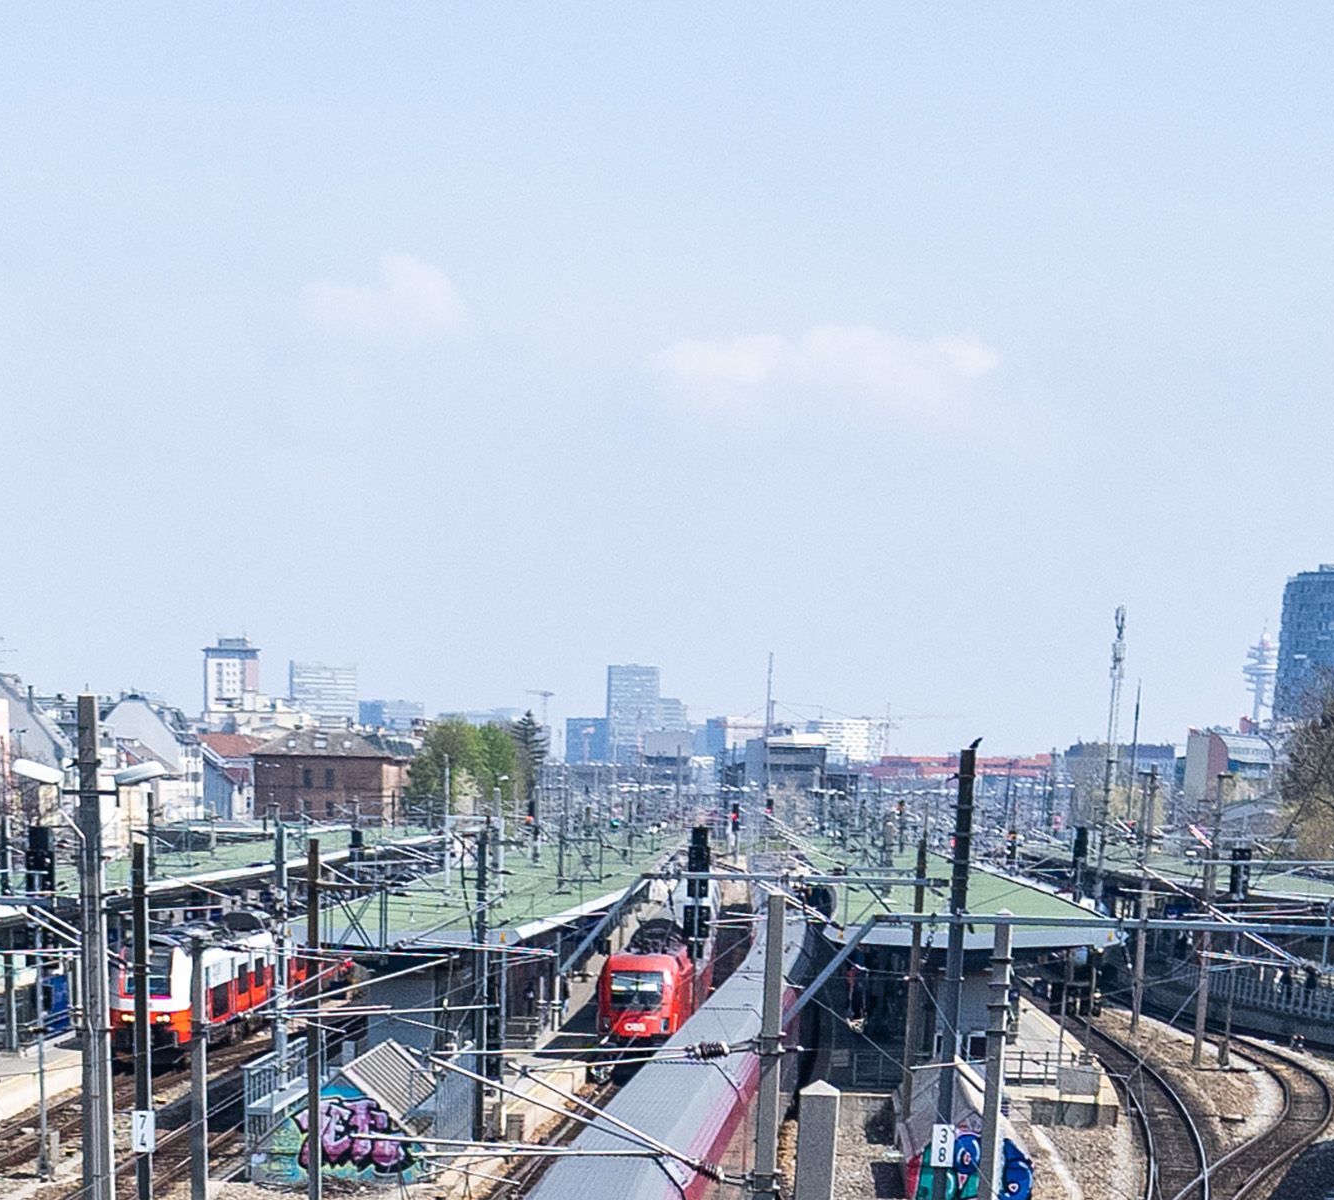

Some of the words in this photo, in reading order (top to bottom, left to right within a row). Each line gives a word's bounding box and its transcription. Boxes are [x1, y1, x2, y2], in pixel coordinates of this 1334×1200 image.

[139, 1114, 147, 1130] 7
[939, 1128, 948, 1144] 3
[938, 1147, 947, 1163] 8
